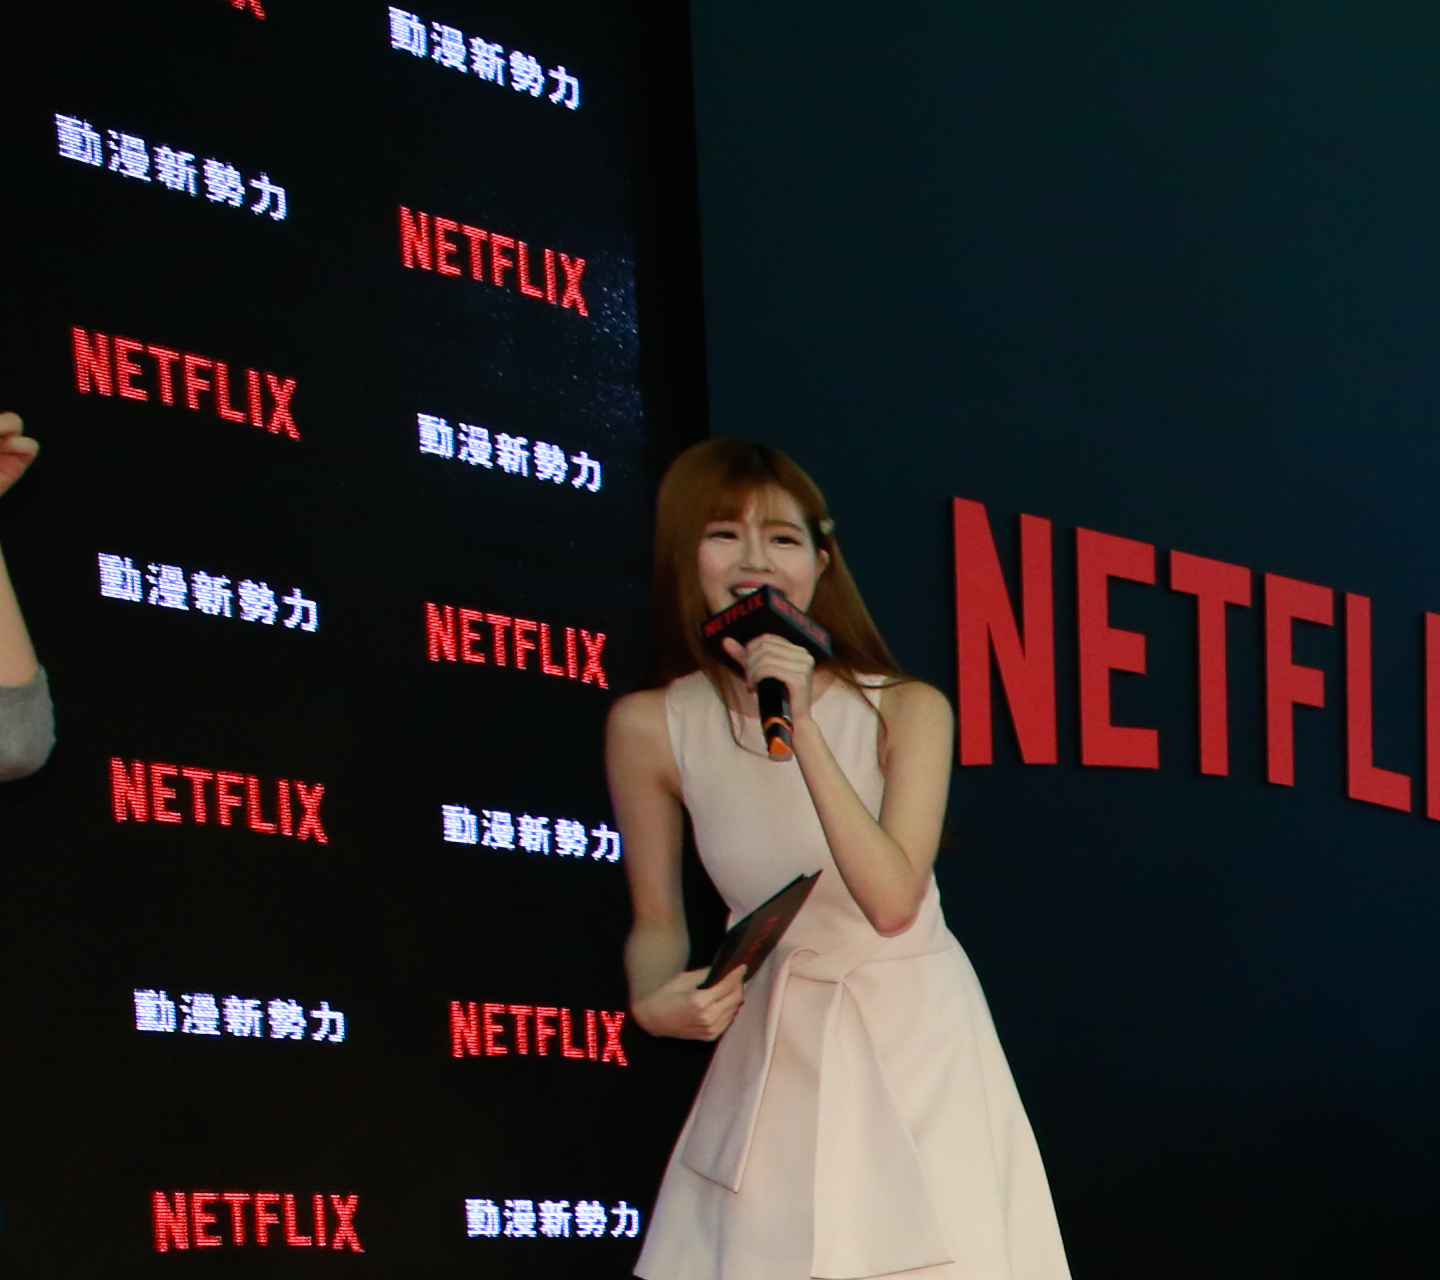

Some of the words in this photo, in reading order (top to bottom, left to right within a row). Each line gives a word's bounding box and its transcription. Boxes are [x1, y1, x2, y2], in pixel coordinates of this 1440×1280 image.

[388, 6, 580, 110] 動漫新勢力
[55, 114, 287, 220] 動漫新勢力
[400, 206, 588, 316] NETFLIX
[72, 326, 300, 440] NETFLIX
[417, 413, 601, 492] 動漫新勢力
[98, 553, 318, 632] 動漫新勢力
[425, 603, 608, 689] NETFLIX
[110, 757, 328, 844] NETFLIX
[441, 805, 622, 862] 動漫新勢力
[134, 989, 345, 1042] 動漫新勢力
[449, 1001, 628, 1066] NETFLIX
[152, 1190, 364, 1253] NETFLIX
[464, 1199, 640, 1238] 動漫新勢力
